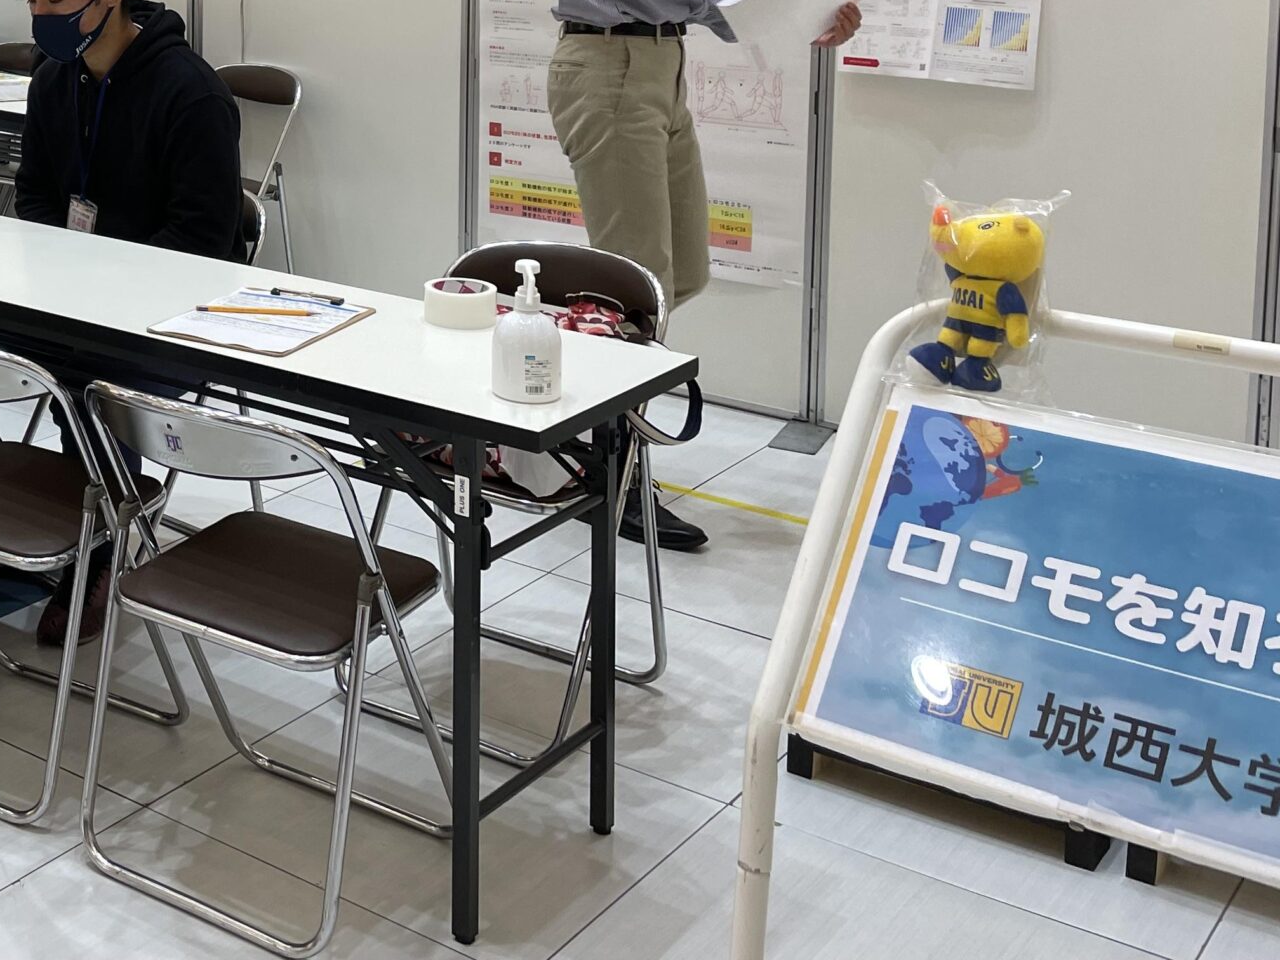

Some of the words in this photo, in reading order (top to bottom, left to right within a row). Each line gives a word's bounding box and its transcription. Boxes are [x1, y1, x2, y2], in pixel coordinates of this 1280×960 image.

[887, 521, 1280, 677] ロコモを知
[969, 672, 1016, 690] UNIVERSITY
